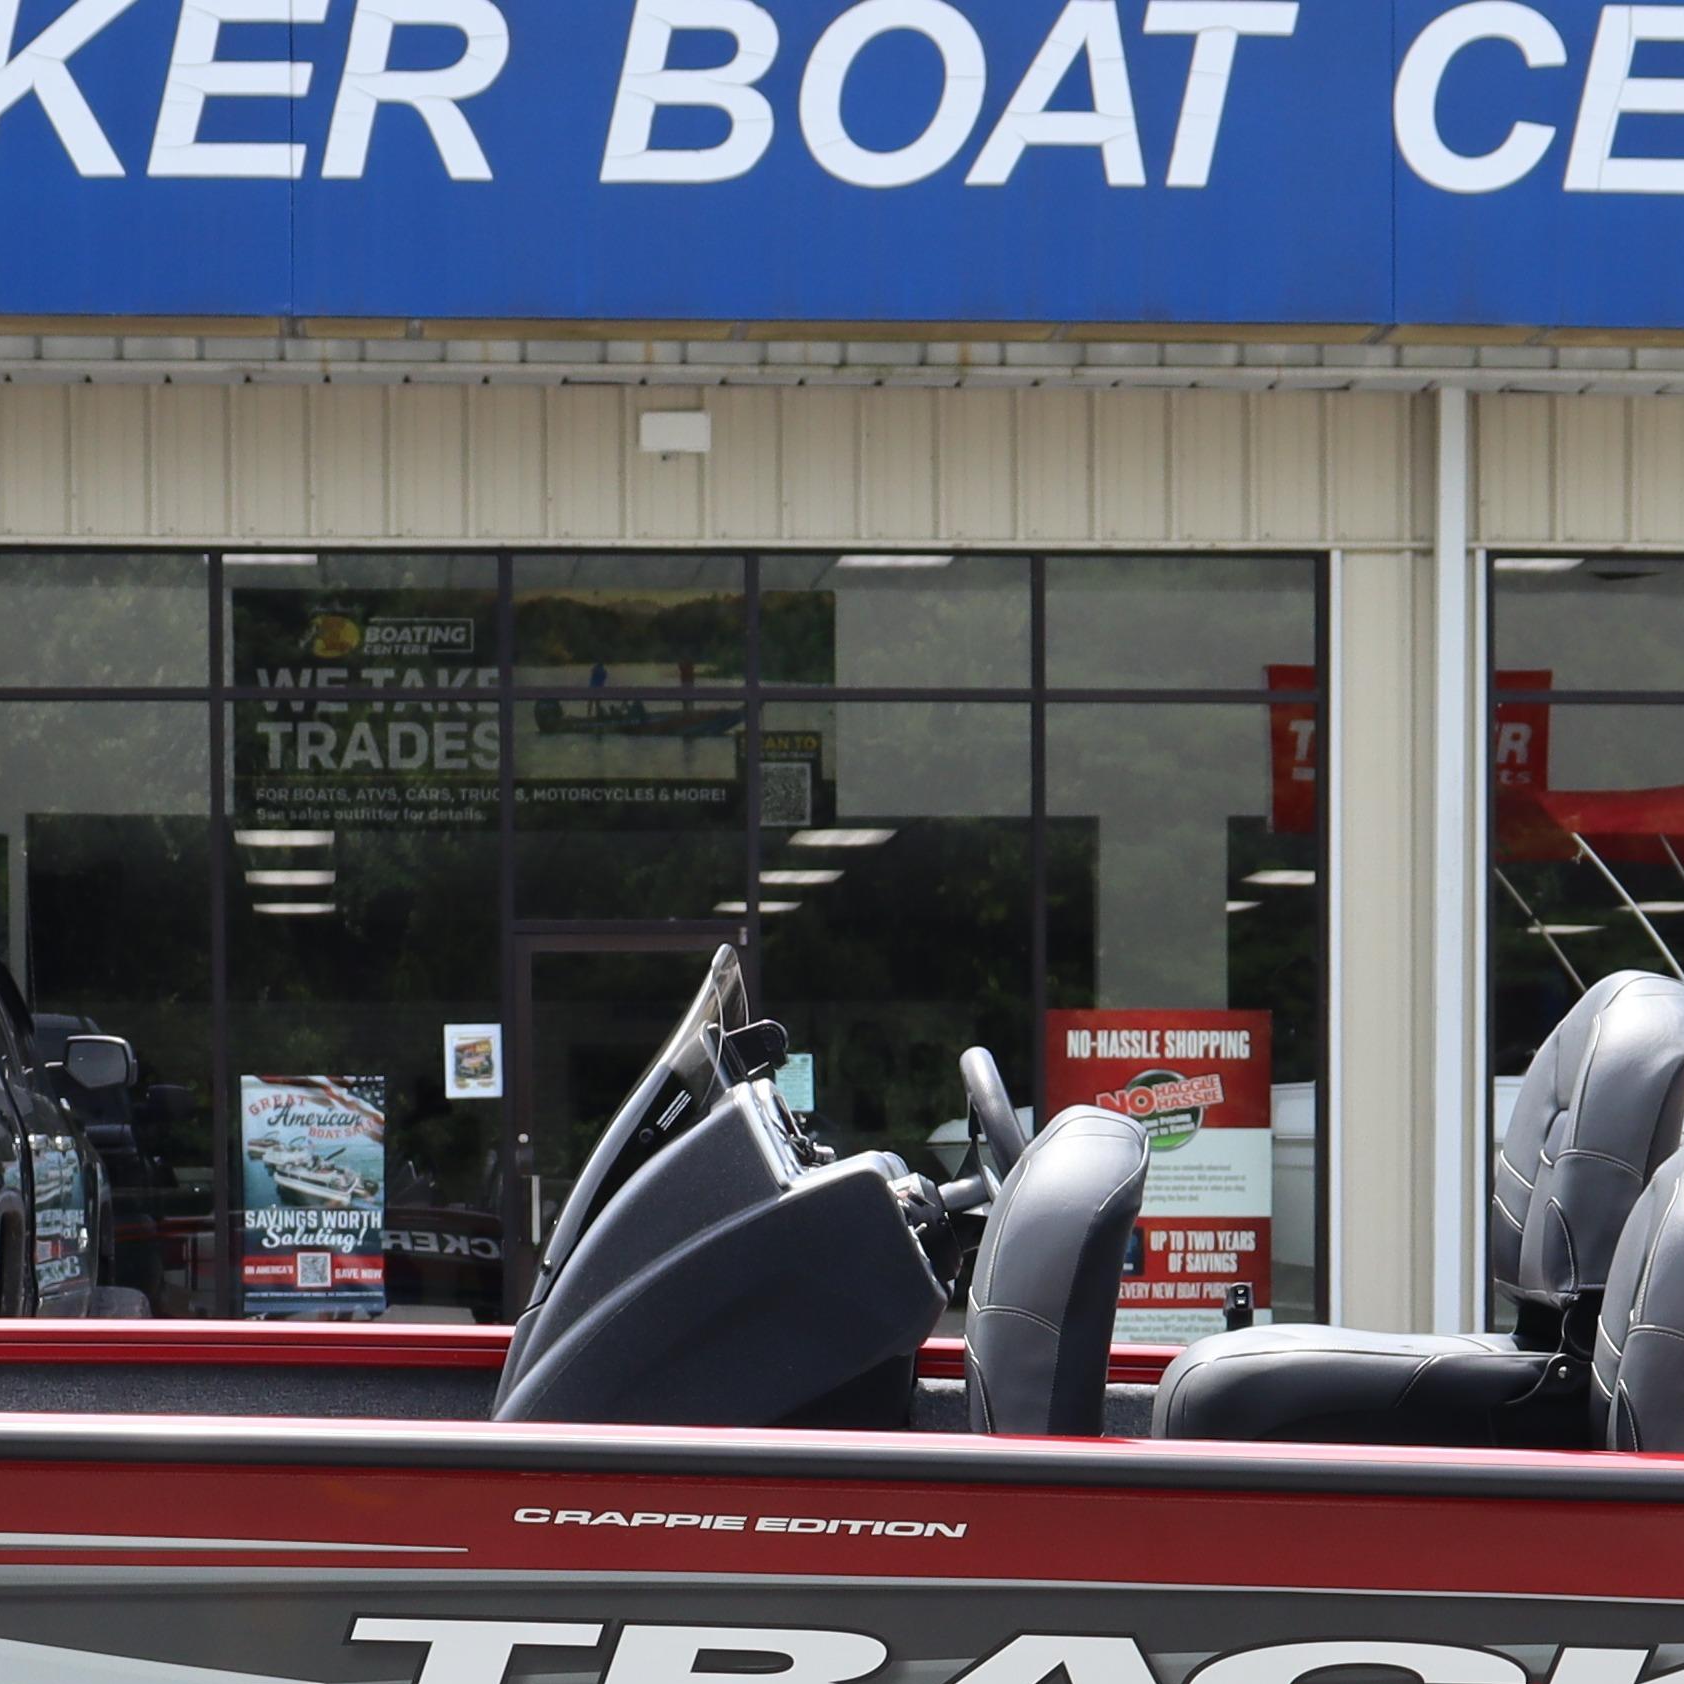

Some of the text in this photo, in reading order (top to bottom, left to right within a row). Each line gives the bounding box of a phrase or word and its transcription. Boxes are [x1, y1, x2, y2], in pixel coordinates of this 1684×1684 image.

[597, 0, 1300, 188] BOAT
[364, 626, 467, 643] BOATING
[363, 644, 430, 657] CENTERS
[256, 667, 500, 712] WE TAKE
[255, 721, 500, 770] TRADES
[256, 787, 726, 803] FOR BOATS, ATVS, CARS, TRUCS, MOTORCYCLES & MORE!
[256, 808, 283, 821] See
[335, 807, 398, 821] outfitter
[402, 807, 425, 821] for
[428, 807, 488, 821] details.
[1067, 1029, 1251, 1060] NO-HASSLE SHOPPING
[1153, 1074, 1221, 1097] HAGGLE
[248, 1094, 307, 1116] GREAT
[1096, 1086, 1223, 1117] NO HASSLE
[267, 1104, 363, 1127] American
[307, 1123, 342, 1139] BOAT
[245, 1210, 383, 1230] SAVINGS WORTH
[261, 1221, 367, 1254] Saluting!
[1149, 1230, 1257, 1252] UP TO TWO YEARS
[1168, 1252, 1238, 1273] OF SAVINGS
[334, 1268, 383, 1280] SAVE NOW
[1119, 1281, 1150, 1300] EVERY
[1151, 1281, 1176, 1300] NEW
[1176, 1281, 1202, 1300] BOAT
[513, 1506, 969, 1540] CRAPPIE EDITION
